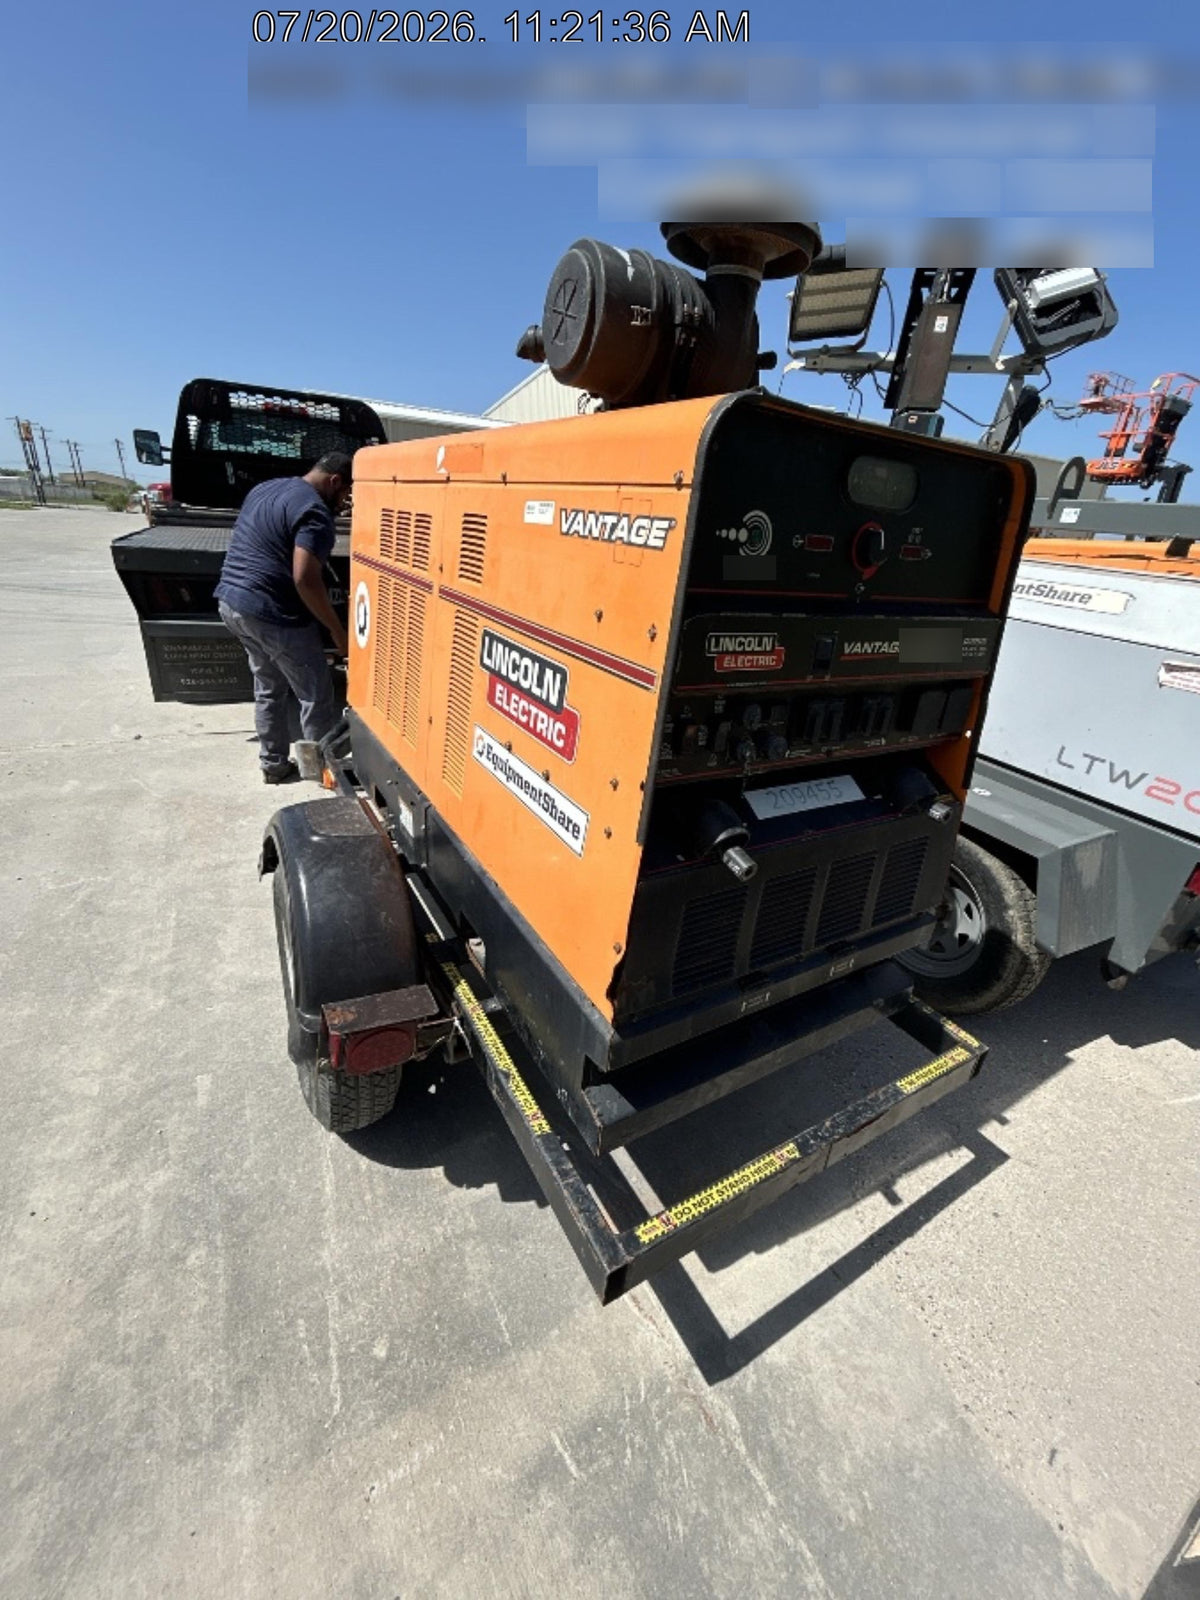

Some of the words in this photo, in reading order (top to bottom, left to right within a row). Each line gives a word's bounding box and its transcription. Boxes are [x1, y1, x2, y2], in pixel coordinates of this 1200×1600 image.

[560, 509, 670, 548] VANTAGE
[1012, 582, 1093, 605] ntShare
[710, 635, 775, 652] LINCOLN
[722, 654, 777, 667] ELECTRIC
[843, 641, 900, 655] VANTAG
[482, 635, 562, 707] LINCOLN
[494, 683, 567, 748] ELECTRIC
[484, 742, 582, 841] EquipmentShare
[673, 1206, 693, 1221] DO
[692, 1193, 716, 1211] NOT
[715, 1174, 751, 1197] STAND
